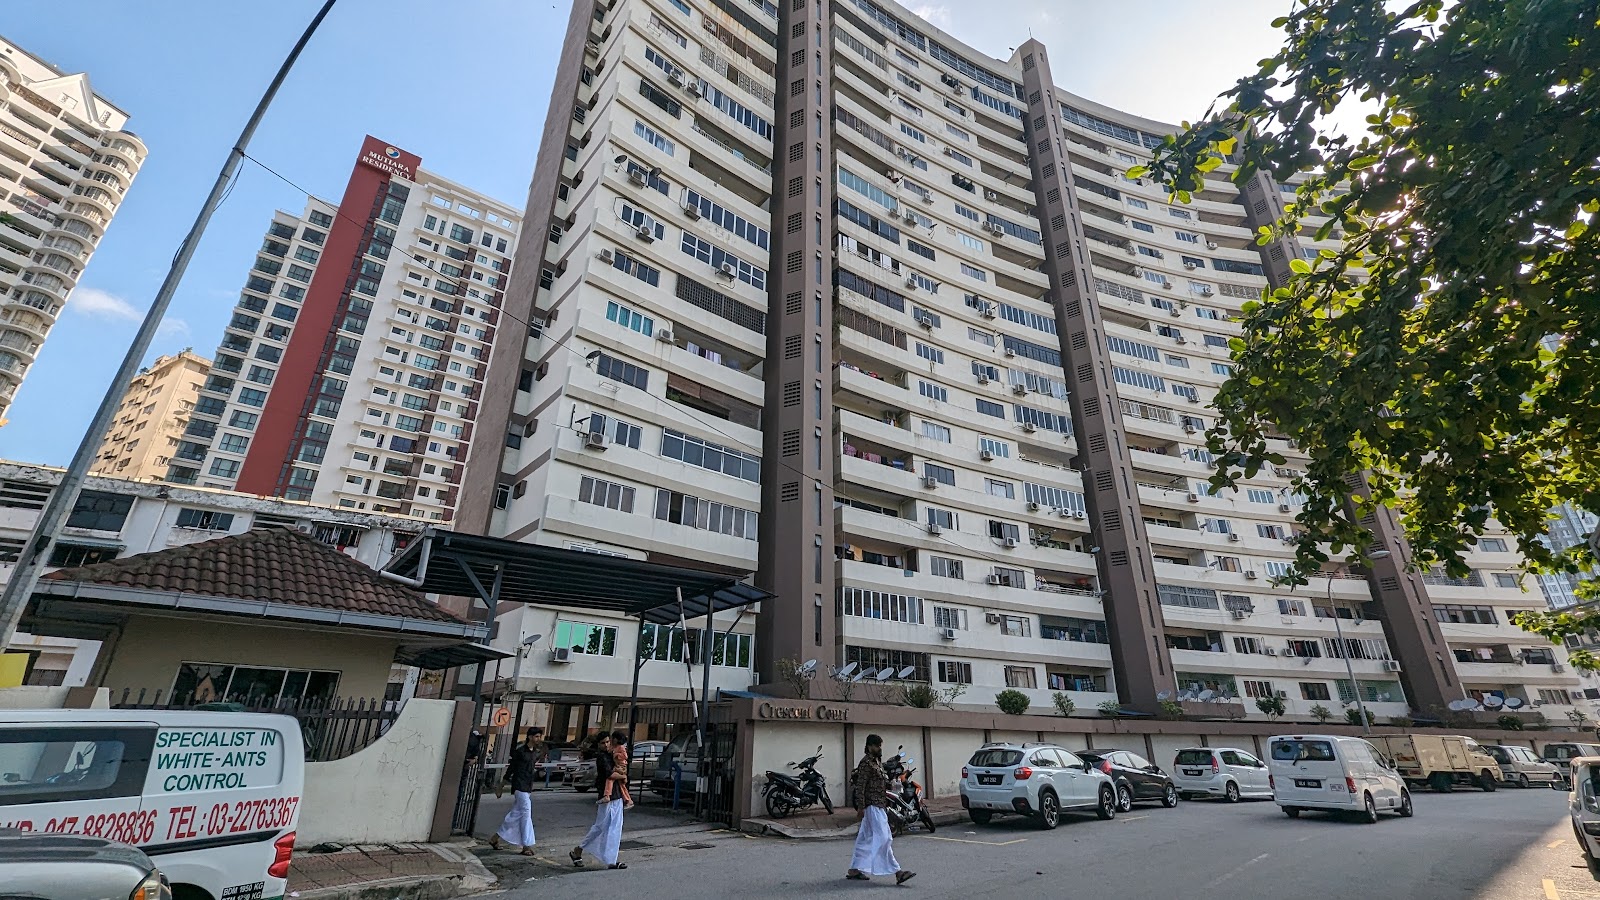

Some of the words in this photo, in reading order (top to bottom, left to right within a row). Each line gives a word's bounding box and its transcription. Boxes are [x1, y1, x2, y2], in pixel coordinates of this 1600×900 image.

[362, 156, 412, 180] RESIDENCY
[368, 151, 410, 173] MUTIARA
[759, 702, 812, 719] Crescent
[816, 705, 850, 721] Court
[156, 732, 255, 748] SPECIALIST
[261, 732, 277, 746] IN
[157, 751, 267, 770] WHITE-ANTS
[163, 773, 247, 792] CONTROL
[253, 882, 264, 890] KG
